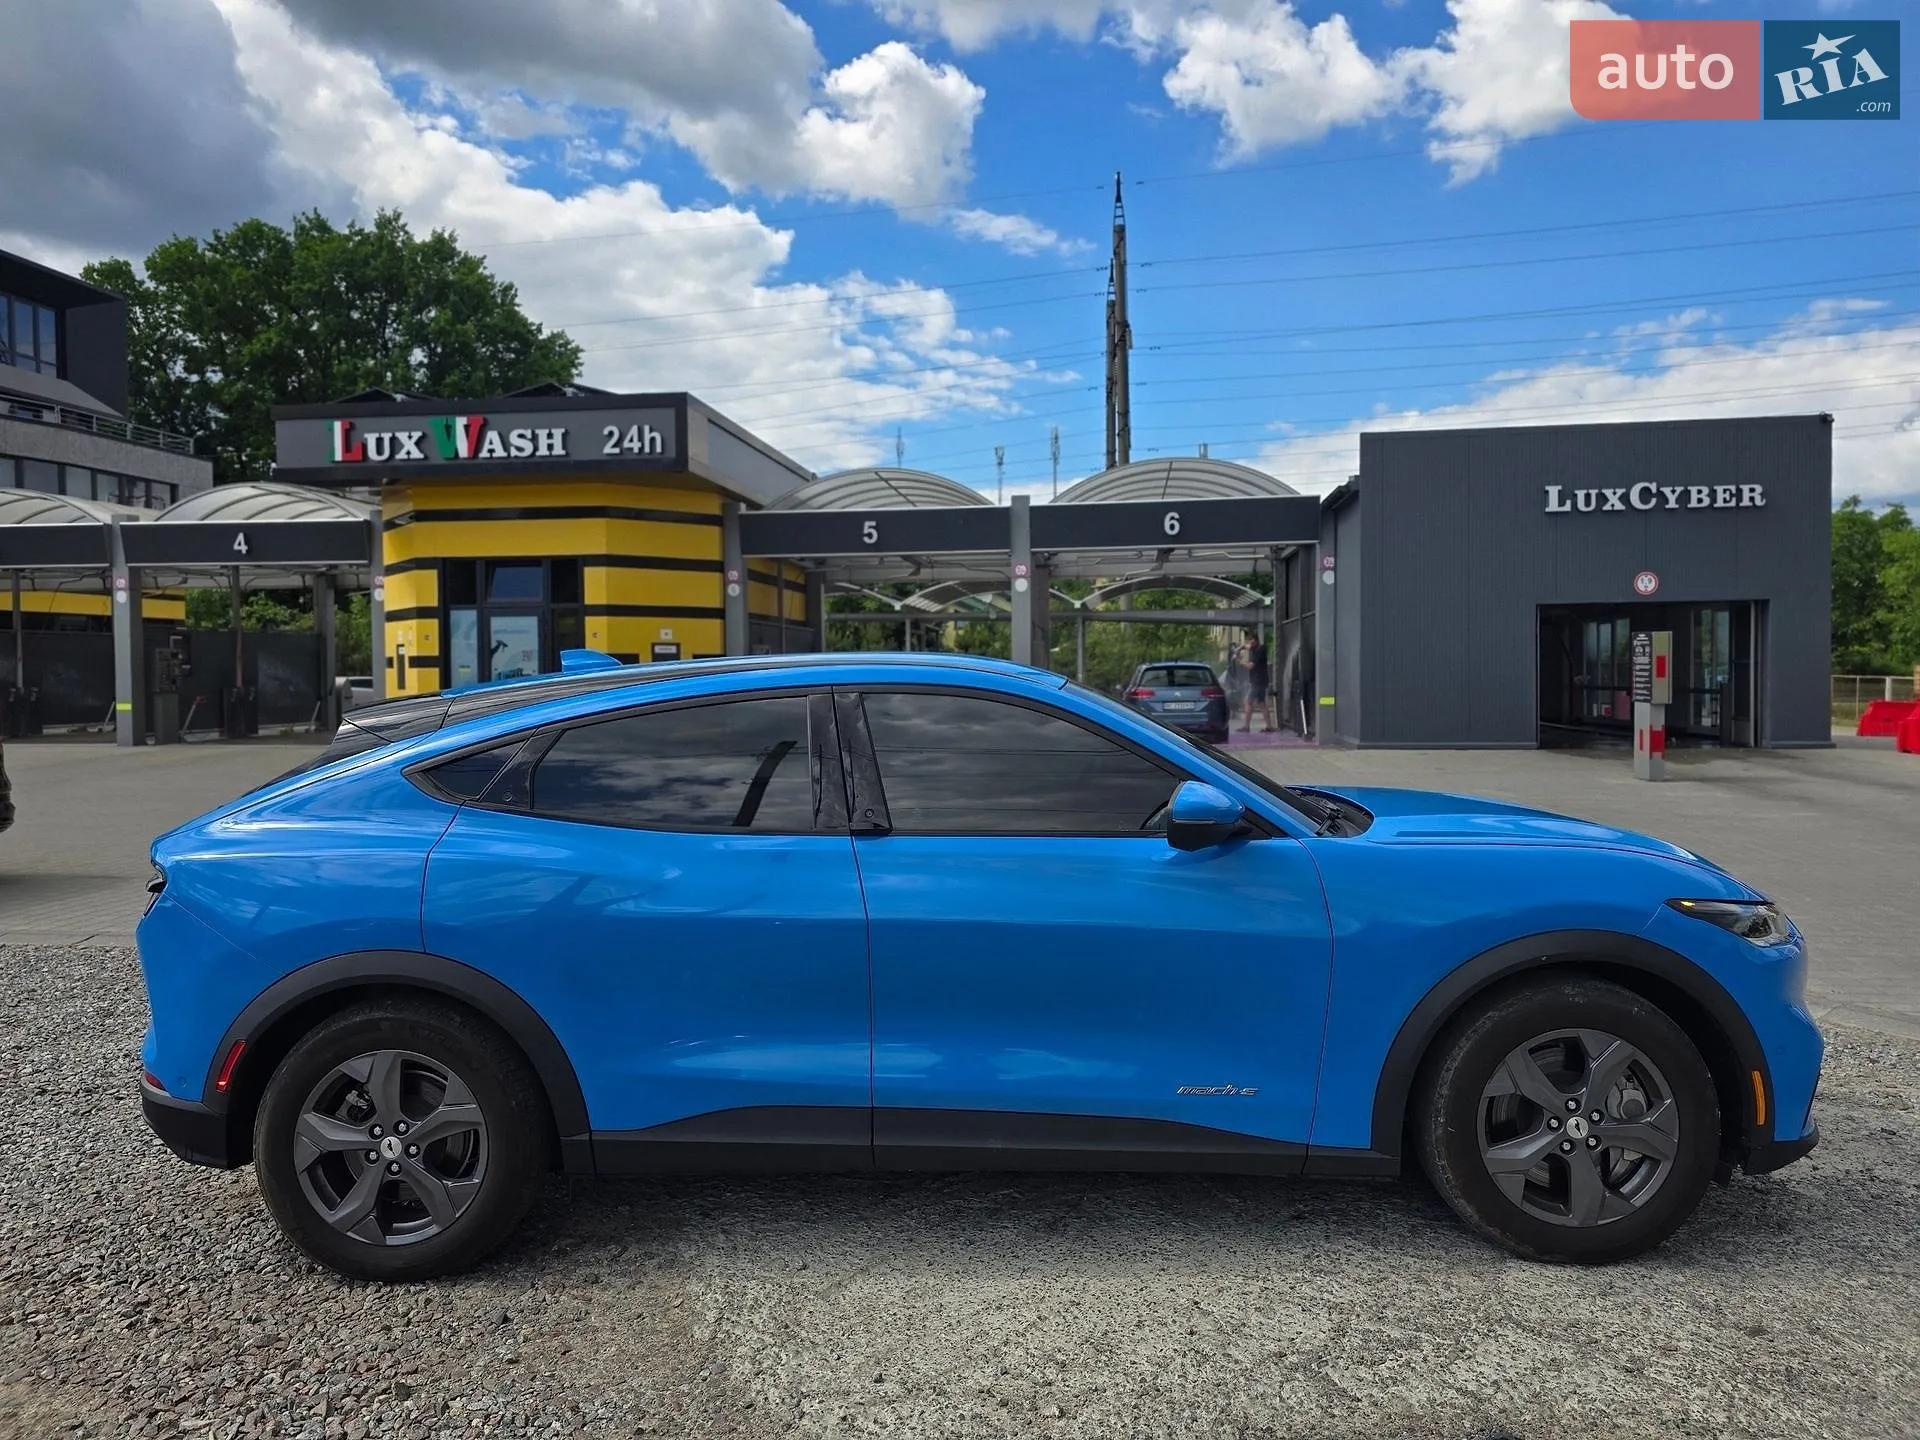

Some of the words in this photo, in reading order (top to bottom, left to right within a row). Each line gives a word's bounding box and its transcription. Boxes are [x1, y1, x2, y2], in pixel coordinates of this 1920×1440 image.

[326, 419, 424, 462] LUX
[428, 416, 567, 461] WASH
[602, 424, 663, 455] 24h
[1544, 481, 1766, 513] LUXCYBER
[863, 520, 878, 544] 5
[1164, 511, 1180, 536] 6
[233, 532, 248, 554] 4
